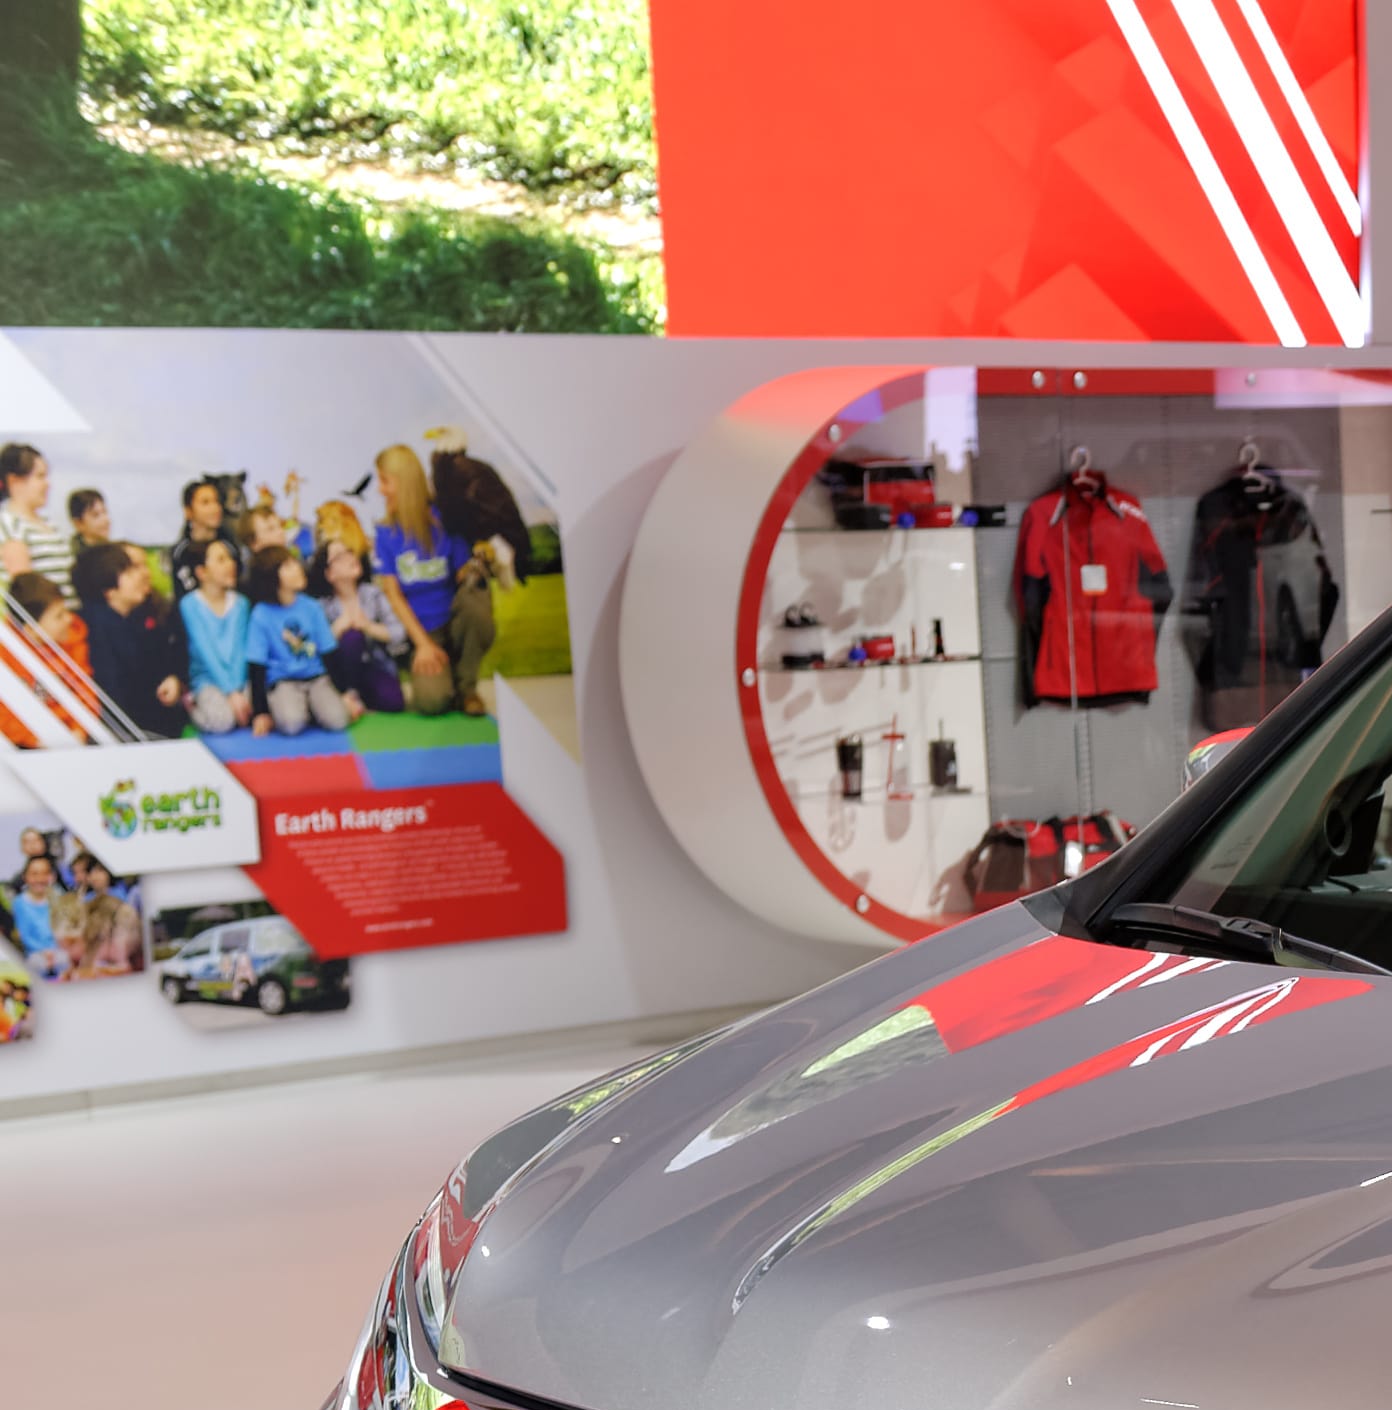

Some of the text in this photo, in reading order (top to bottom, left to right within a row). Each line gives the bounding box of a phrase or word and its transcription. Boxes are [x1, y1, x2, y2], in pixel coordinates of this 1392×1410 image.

[140, 787, 221, 815] earth
[142, 813, 221, 834] rangers
[274, 803, 428, 836] Earth Rangers
